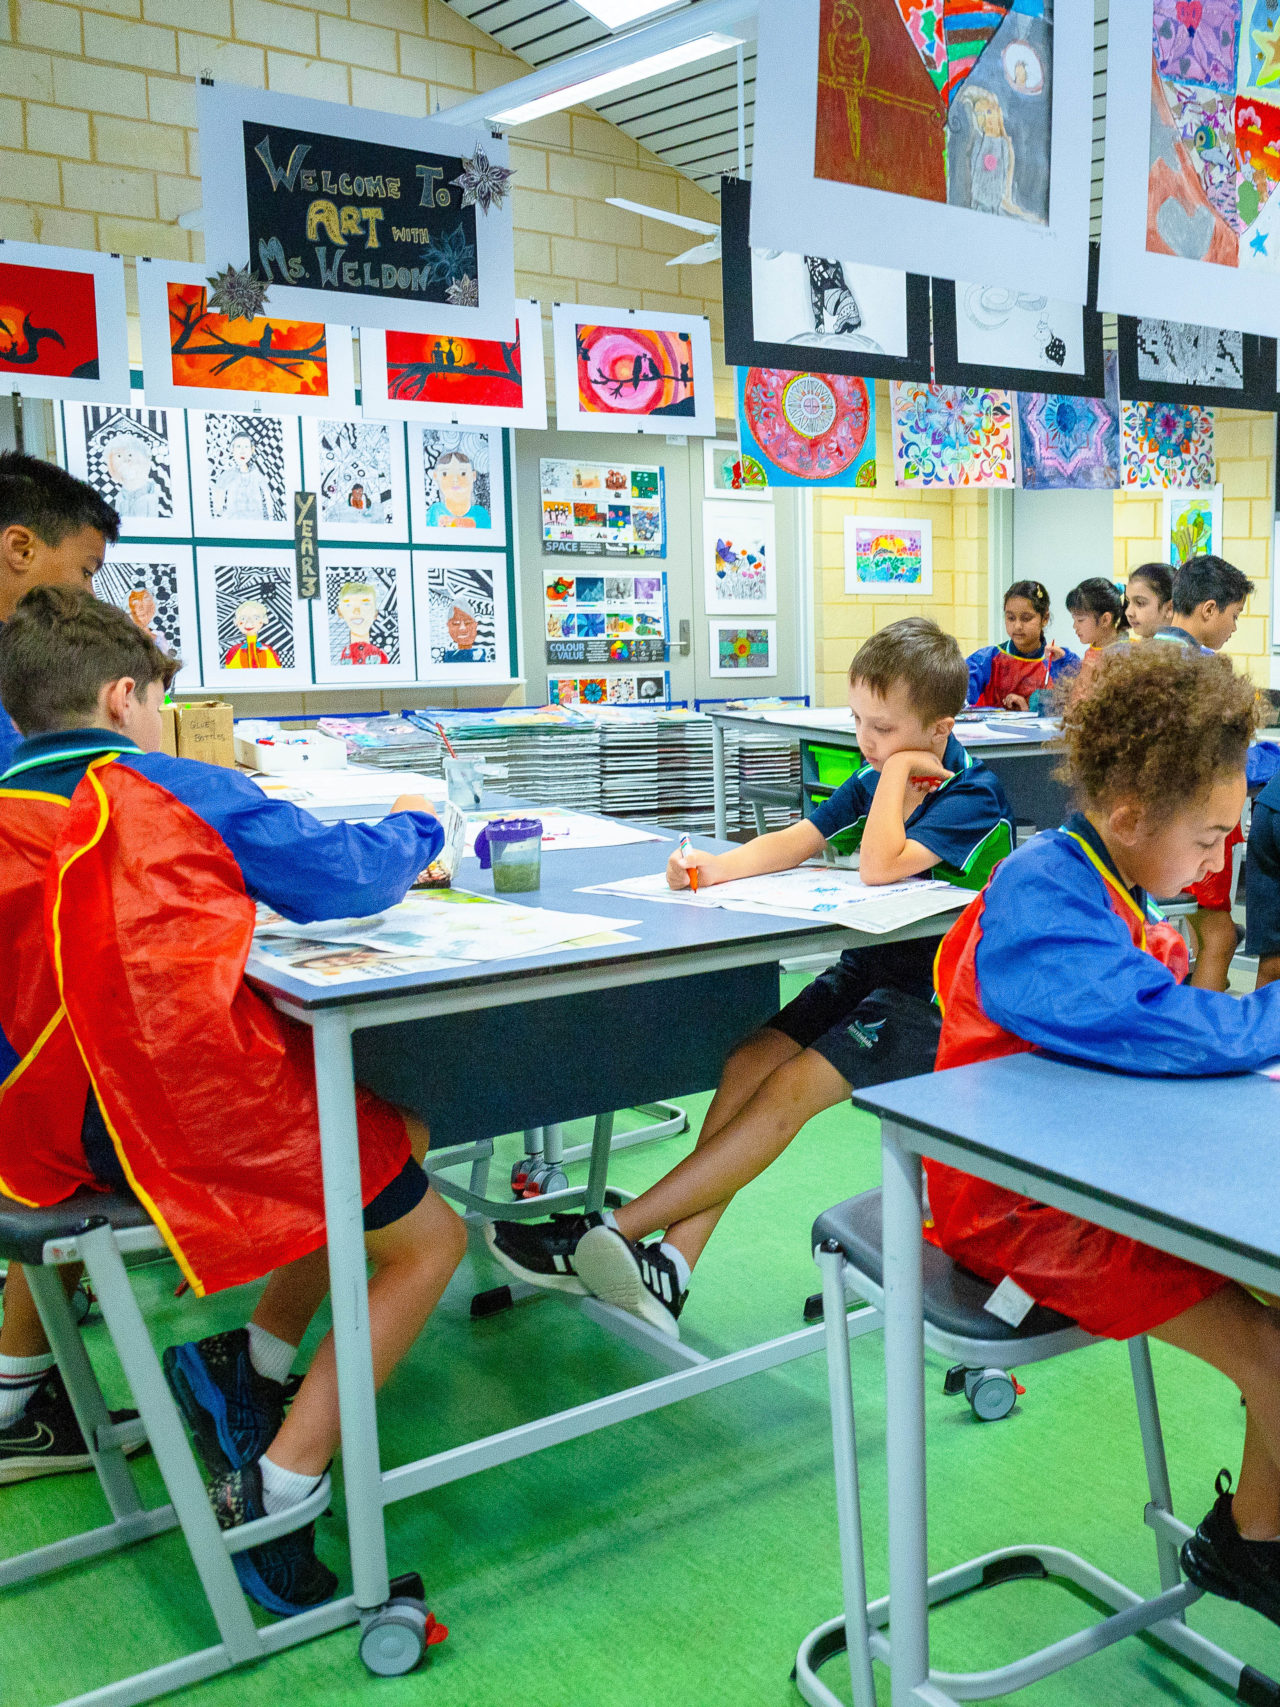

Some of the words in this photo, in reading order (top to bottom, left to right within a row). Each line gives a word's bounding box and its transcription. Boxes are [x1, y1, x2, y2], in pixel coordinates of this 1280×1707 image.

[254, 135, 401, 198] WELCOME
[415, 164, 451, 208] TO
[306, 199, 384, 249] ART
[391, 226, 430, 244] WITH
[315, 246, 432, 292] WELDON
[295, 494, 317, 575] YEAR
[545, 541, 578, 552] SPACE
[301, 576, 318, 597] 3
[550, 643, 585, 652] COLOUR
[557, 651, 585, 660] VALUE
